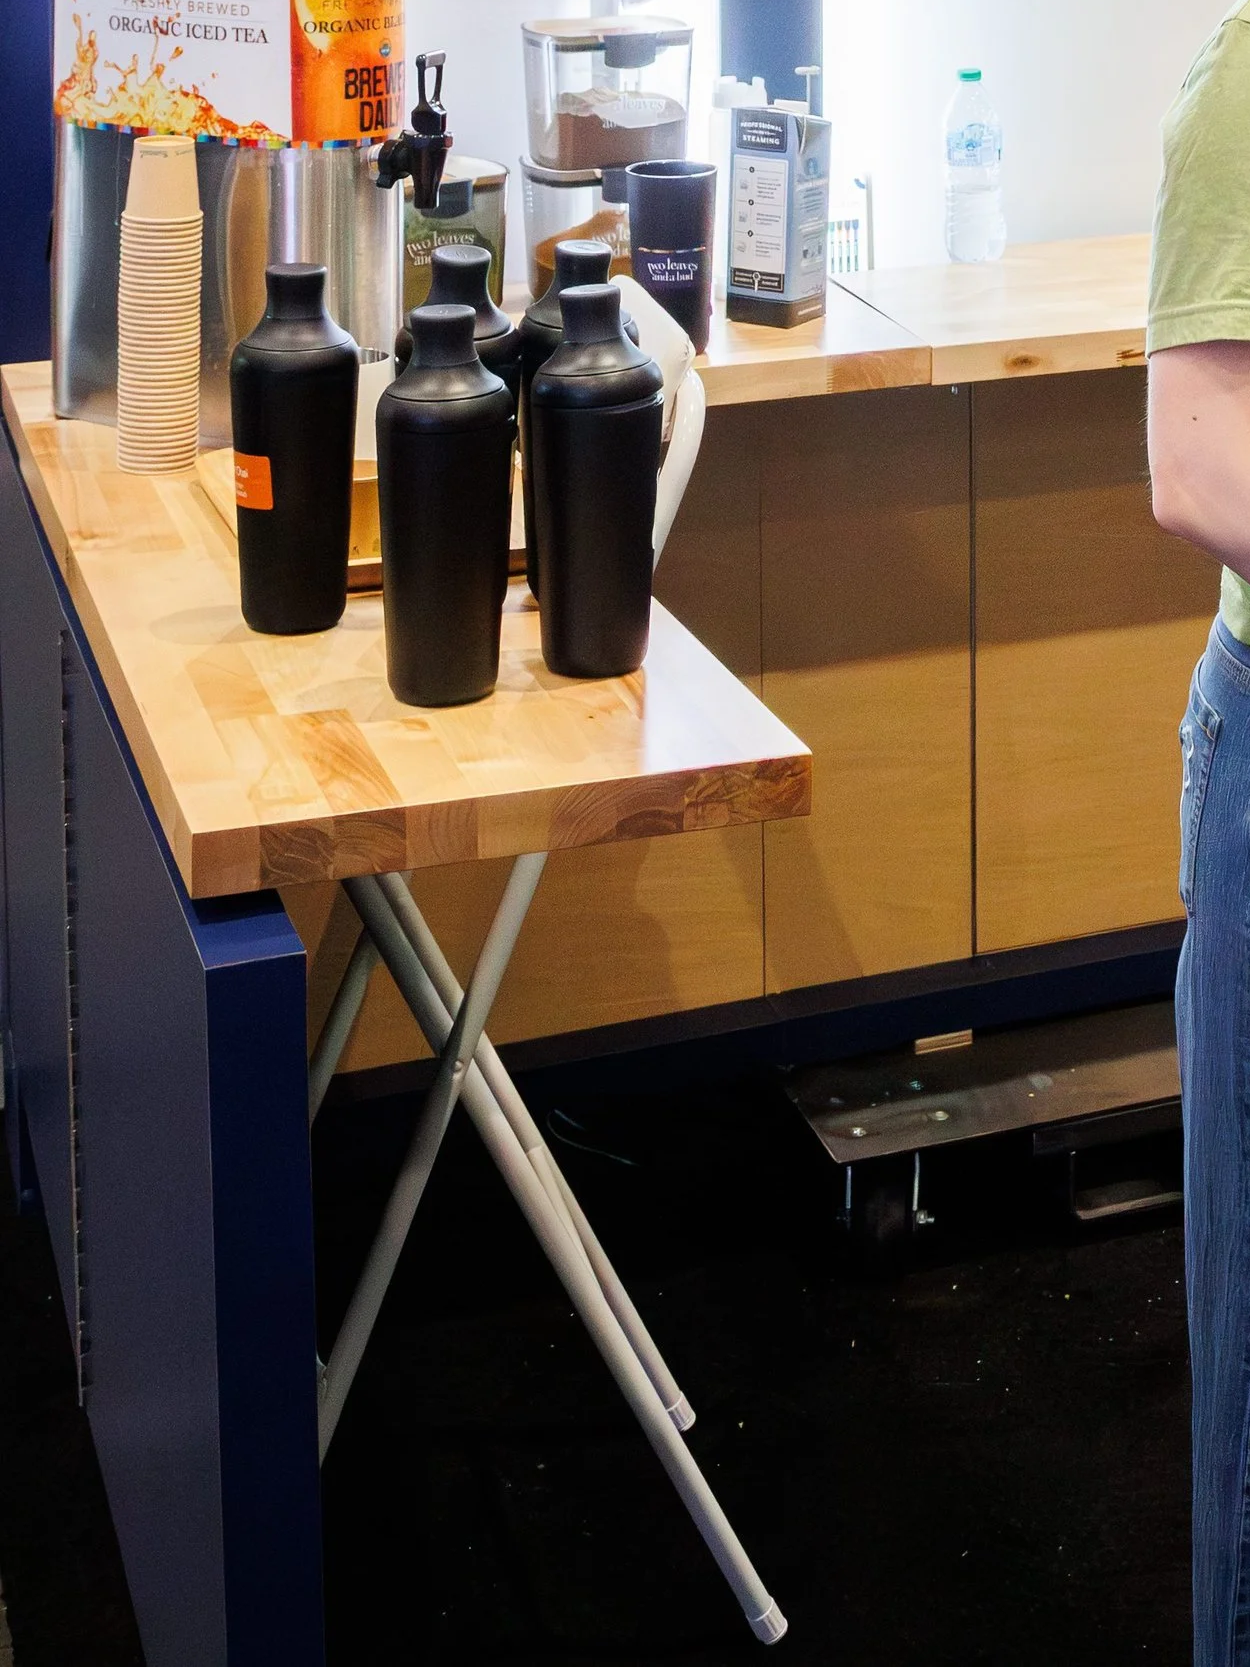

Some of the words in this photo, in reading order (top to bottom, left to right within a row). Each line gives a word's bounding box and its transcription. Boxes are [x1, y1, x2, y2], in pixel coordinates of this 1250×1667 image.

[187, 0, 250, 17] BREWED
[108, 15, 183, 37] ORGANIC
[185, 22, 227, 41] ICED
[231, 27, 269, 44] TEA
[303, 18, 381, 34] ORGANIC
[742, 135, 780, 145] STEAMING
[406, 239, 432, 258] two
[433, 230, 476, 247] leaves
[647, 262, 666, 276] two
[667, 257, 699, 271] leaves
